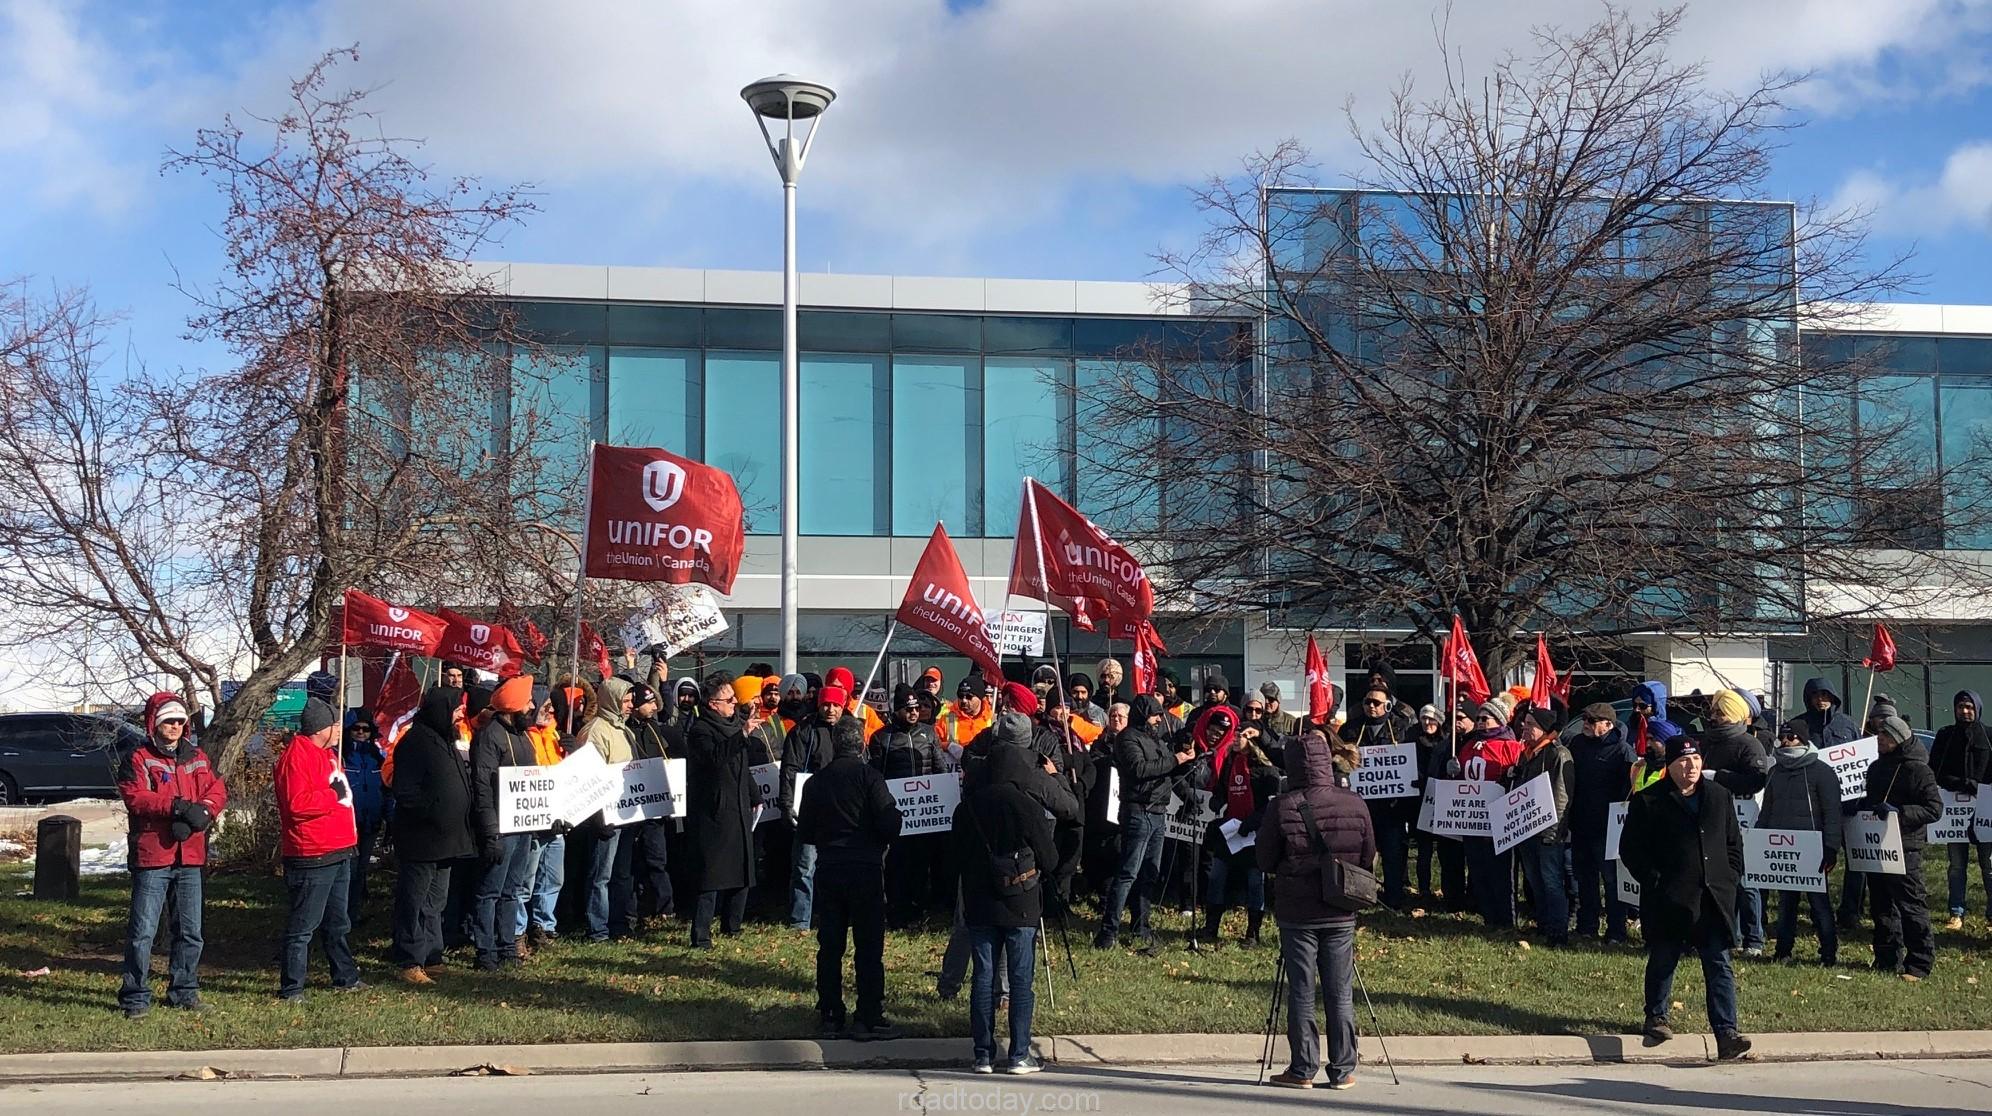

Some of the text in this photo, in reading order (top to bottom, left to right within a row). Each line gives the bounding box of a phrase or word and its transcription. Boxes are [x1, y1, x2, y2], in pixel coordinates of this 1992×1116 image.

[661, 555, 710, 573] Canada
[912, 604, 962, 635] theUnion
[1018, 634, 1033, 643] FIX
[1373, 754, 1408, 767] NEED
[1829, 746, 1856, 762] CN
[1358, 769, 1401, 783] EQUAL
[509, 779, 555, 793] WE NEED
[629, 783, 645, 794] NO
[904, 779, 931, 792] CN
[1356, 783, 1405, 796] RIGHTS
[1458, 784, 1480, 796] CN
[897, 794, 940, 807] WE ARE
[1508, 786, 1529, 806] CN
[516, 796, 549, 811] EQUAL
[1452, 799, 1486, 809] WE ARE
[1505, 798, 1536, 821] WE ARE
[902, 805, 946, 818] OT JUST
[1446, 810, 1466, 819] NOT
[513, 813, 552, 828] RIGHTS
[1437, 820, 1453, 829] PIN
[1503, 806, 1542, 834] NOT JUST
[1951, 818, 1965, 827] IN
[1496, 811, 1553, 848] PIN NUMBERS
[1769, 833, 1795, 846] CN
[1865, 832, 1880, 844] NO
[1763, 850, 1801, 861] SAFETY
[1851, 847, 1899, 862] BULLYING
[1769, 862, 1798, 873] OVER
[1747, 872, 1823, 887] PRODUCTIVITY
